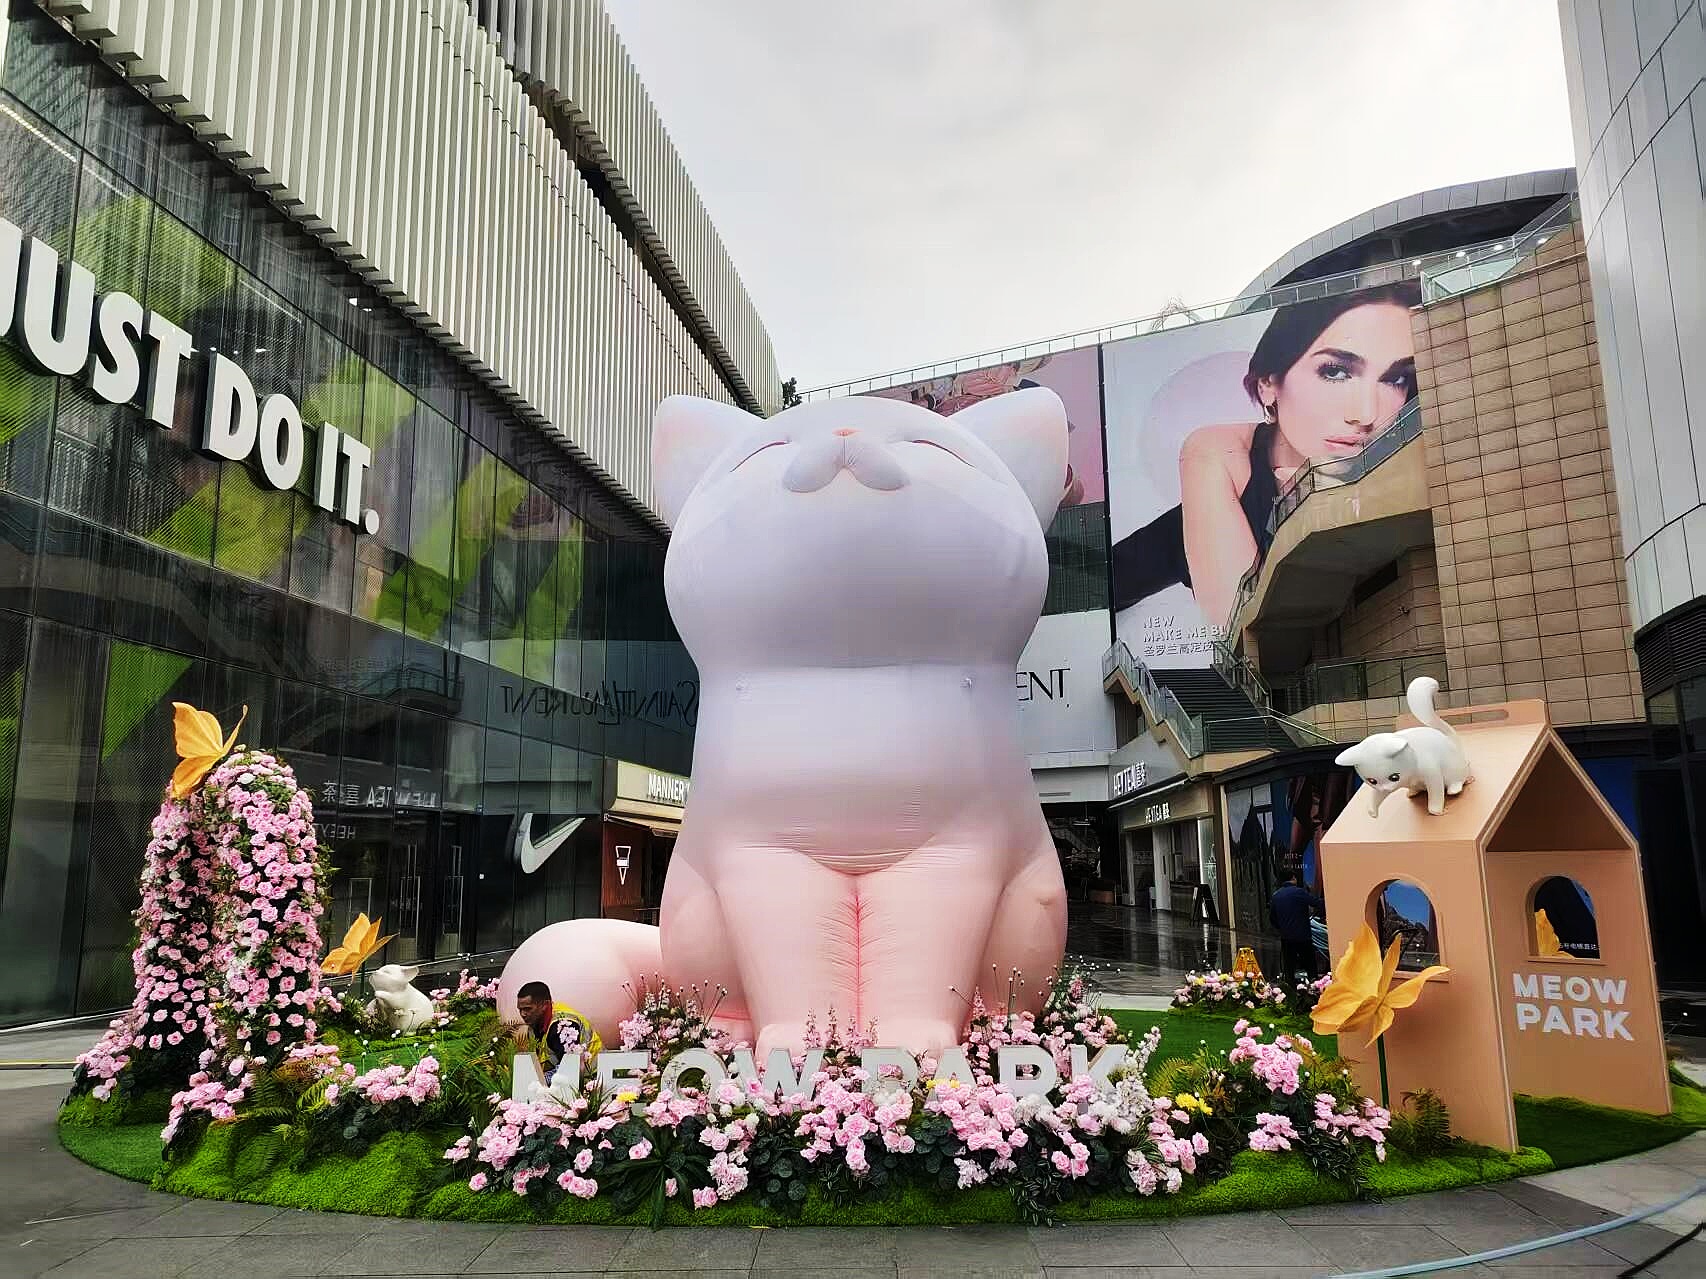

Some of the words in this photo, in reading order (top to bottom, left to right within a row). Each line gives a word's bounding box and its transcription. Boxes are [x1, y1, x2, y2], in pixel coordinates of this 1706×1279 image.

[202, 350, 304, 491] DO
[314, 420, 380, 536] IT.
[1143, 615, 1175, 628] NEW
[1143, 629, 1182, 643] MAKE
[1187, 624, 1207, 639] ME
[648, 773, 684, 803] MANNER
[1512, 973, 1627, 1005] MEOW
[1516, 1003, 1635, 1042] PARK
[511, 1047, 824, 1107] MEOW
[861, 1043, 1131, 1106] PARK
